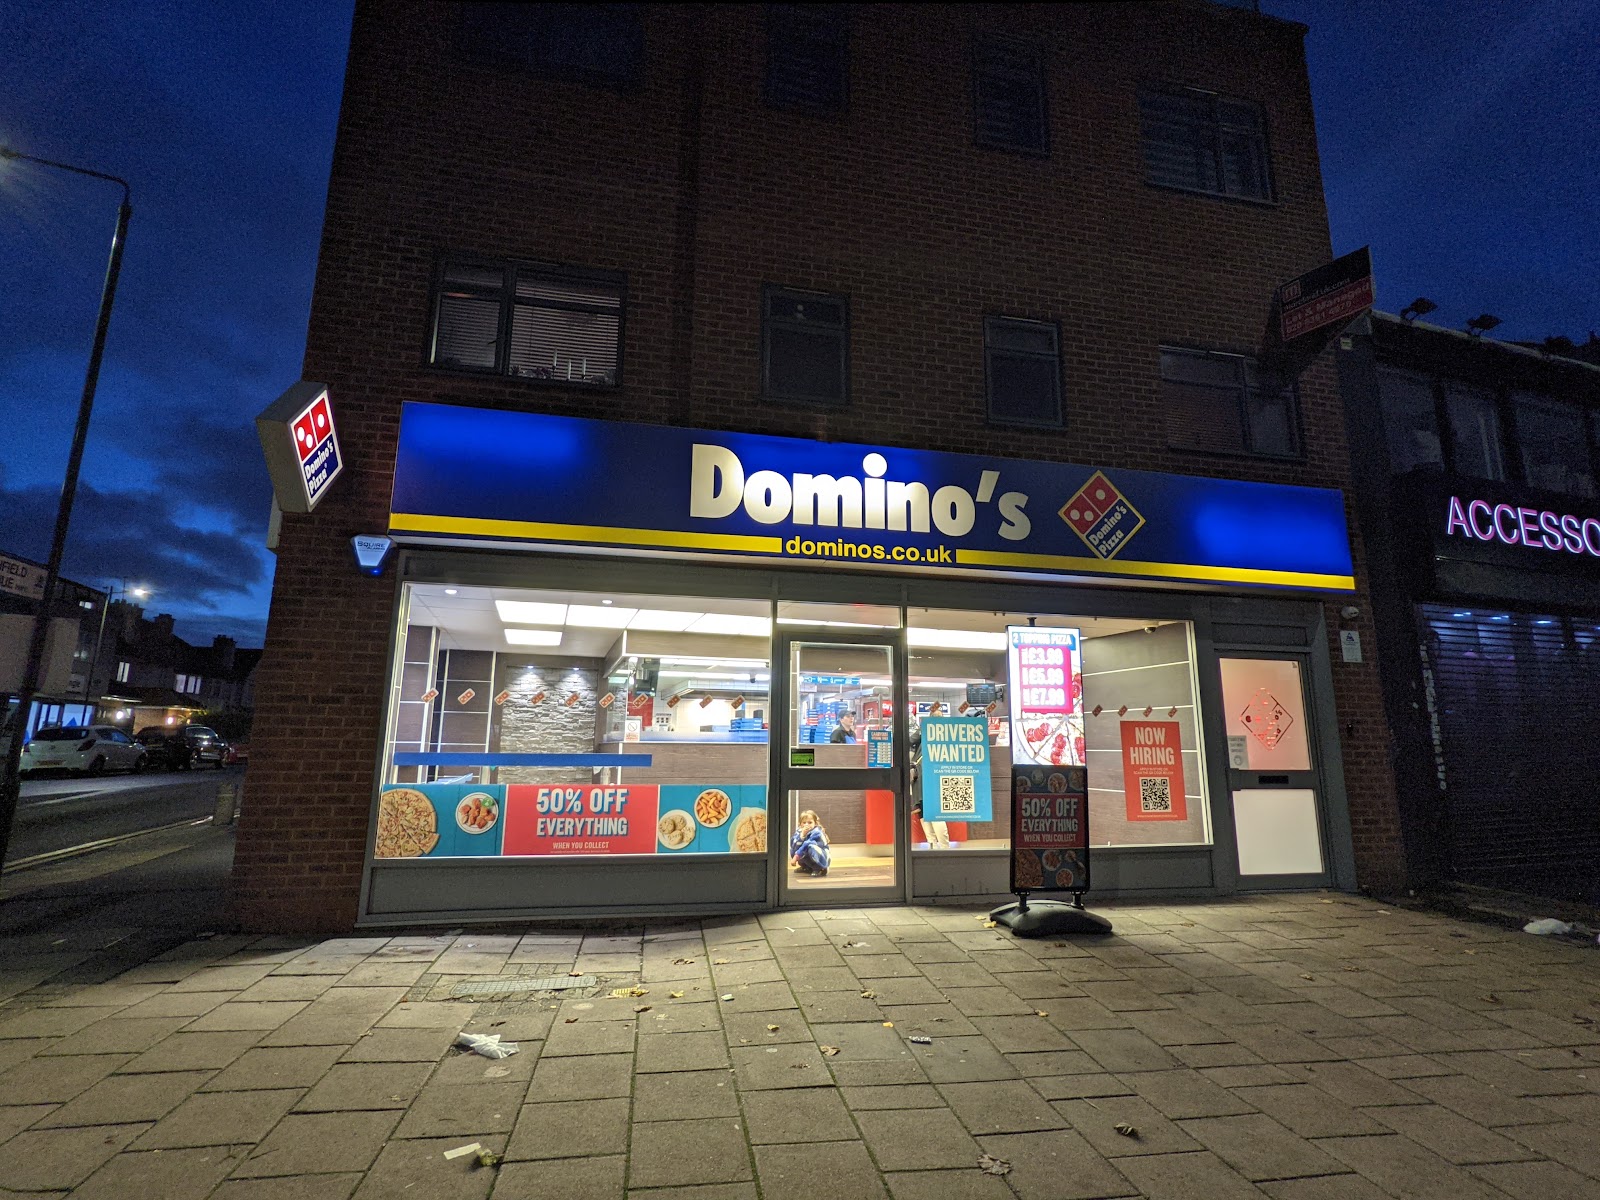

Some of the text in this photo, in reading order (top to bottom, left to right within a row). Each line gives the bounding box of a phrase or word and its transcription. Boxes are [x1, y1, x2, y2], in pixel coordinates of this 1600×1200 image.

[1316, 282, 1370, 312] Managed
[304, 440, 334, 480] Domino's
[308, 468, 328, 495] Pizza
[690, 443, 1031, 541] Domino's
[1088, 504, 1127, 547] Domino's
[1447, 496, 1600, 557] ACCESSO
[785, 536, 953, 564] dominos.co.uk
[1098, 529, 1125, 556] Pizza
[1051, 633, 1073, 645] PIZZA
[926, 723, 984, 742] DRIVERS
[1135, 727, 1166, 745] NOW
[927, 744, 985, 763] WANTED
[1130, 746, 1175, 765] HIRING
[536, 788, 629, 814] 50% OFF
[1021, 797, 1078, 818] 50% OFF
[536, 817, 629, 837] EVERYTHING
[1021, 818, 1079, 833] EVERYTHING
[584, 841, 609, 849] COLLECT
[1023, 833, 1076, 843] WHEN YOU COLLECT
